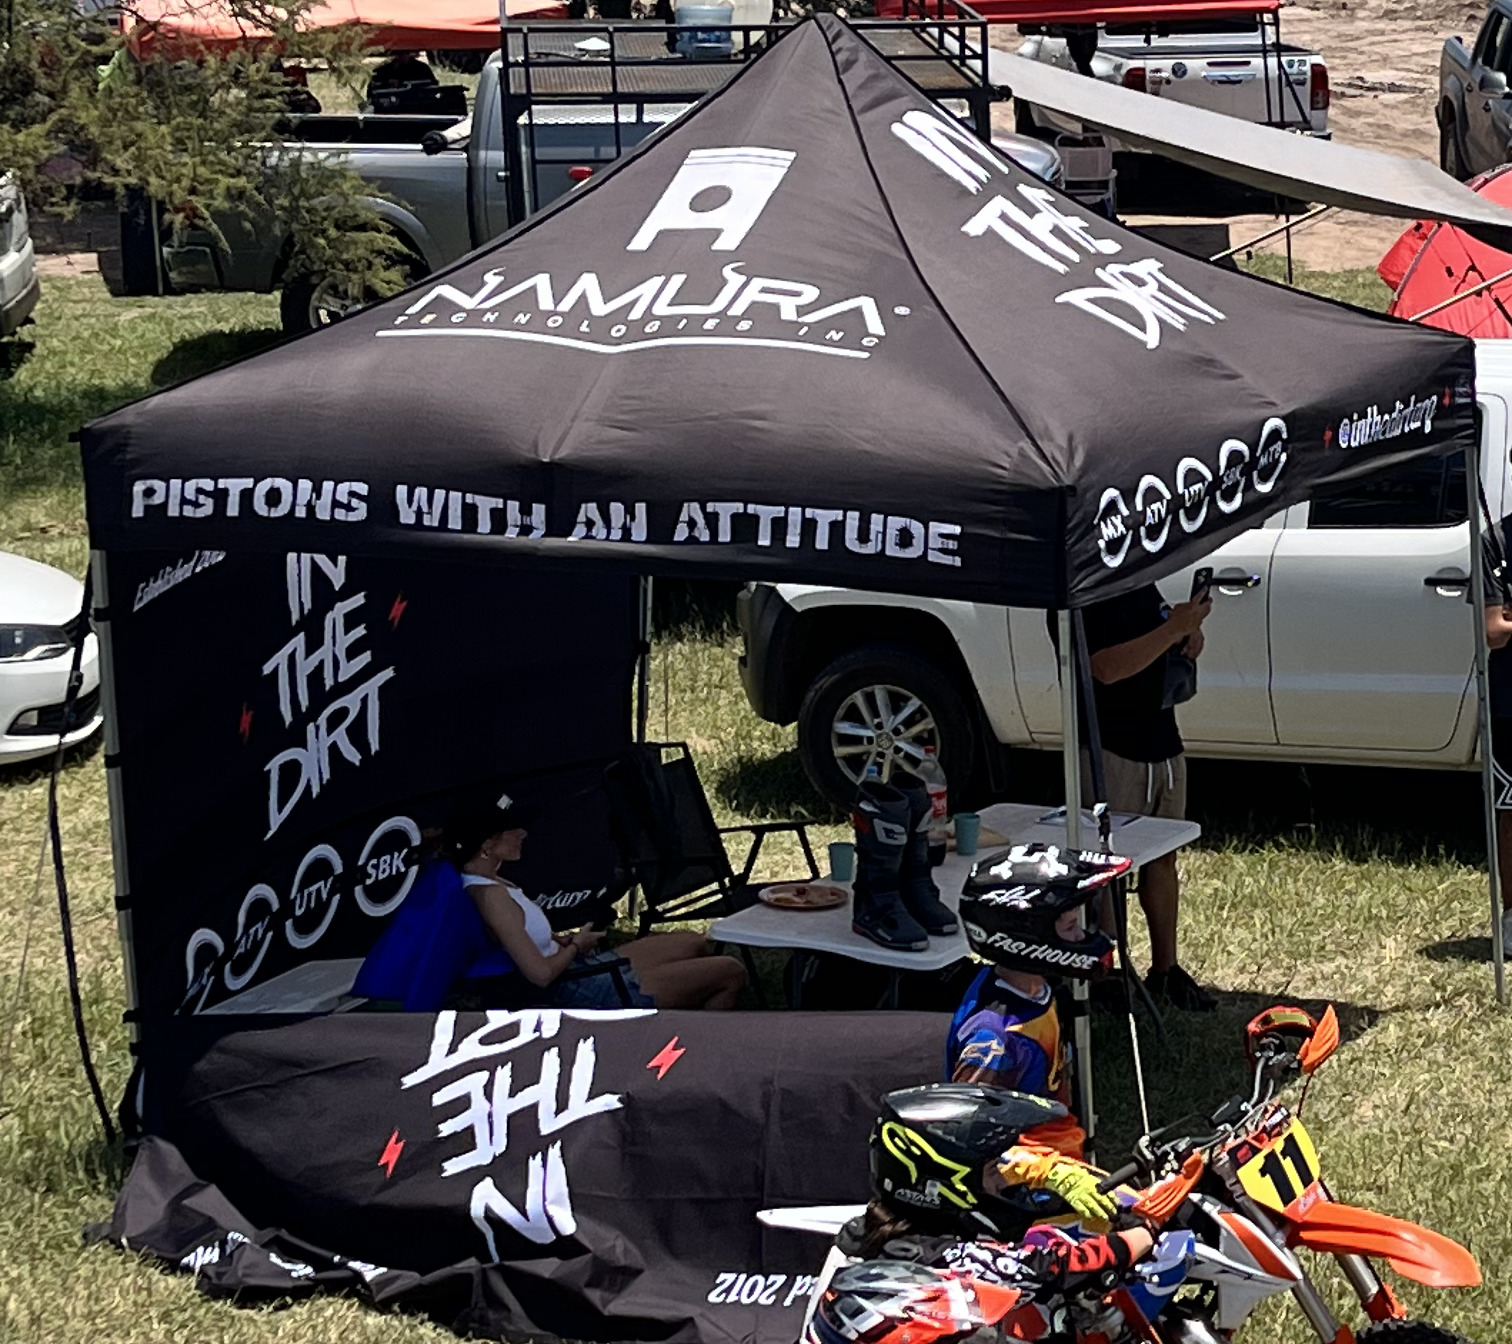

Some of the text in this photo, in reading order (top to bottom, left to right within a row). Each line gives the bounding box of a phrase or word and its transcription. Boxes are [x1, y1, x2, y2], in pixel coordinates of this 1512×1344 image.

[891, 104, 1009, 196] IN
[960, 182, 1122, 276] THE
[394, 311, 754, 338] TECHNOLOGIES
[405, 261, 887, 337] NAMURA
[1055, 258, 1227, 350] DIRT
[130, 477, 963, 568] PISTONS WITH AN ATTITUDE
[1099, 514, 1128, 542] MX
[1144, 498, 1168, 528] ATV
[1183, 479, 1209, 508] UTV
[286, 551, 347, 628] IN
[261, 590, 372, 730] THE
[263, 665, 397, 842] DIRT
[293, 875, 335, 916] UTV
[366, 847, 408, 886] SBK
[235, 914, 271, 956] ATV
[986, 931, 1099, 970] FASTHOUSE
[432, 1035, 625, 1178] THE
[1258, 1132, 1315, 1208] 11
[707, 1271, 788, 1306] 2012
